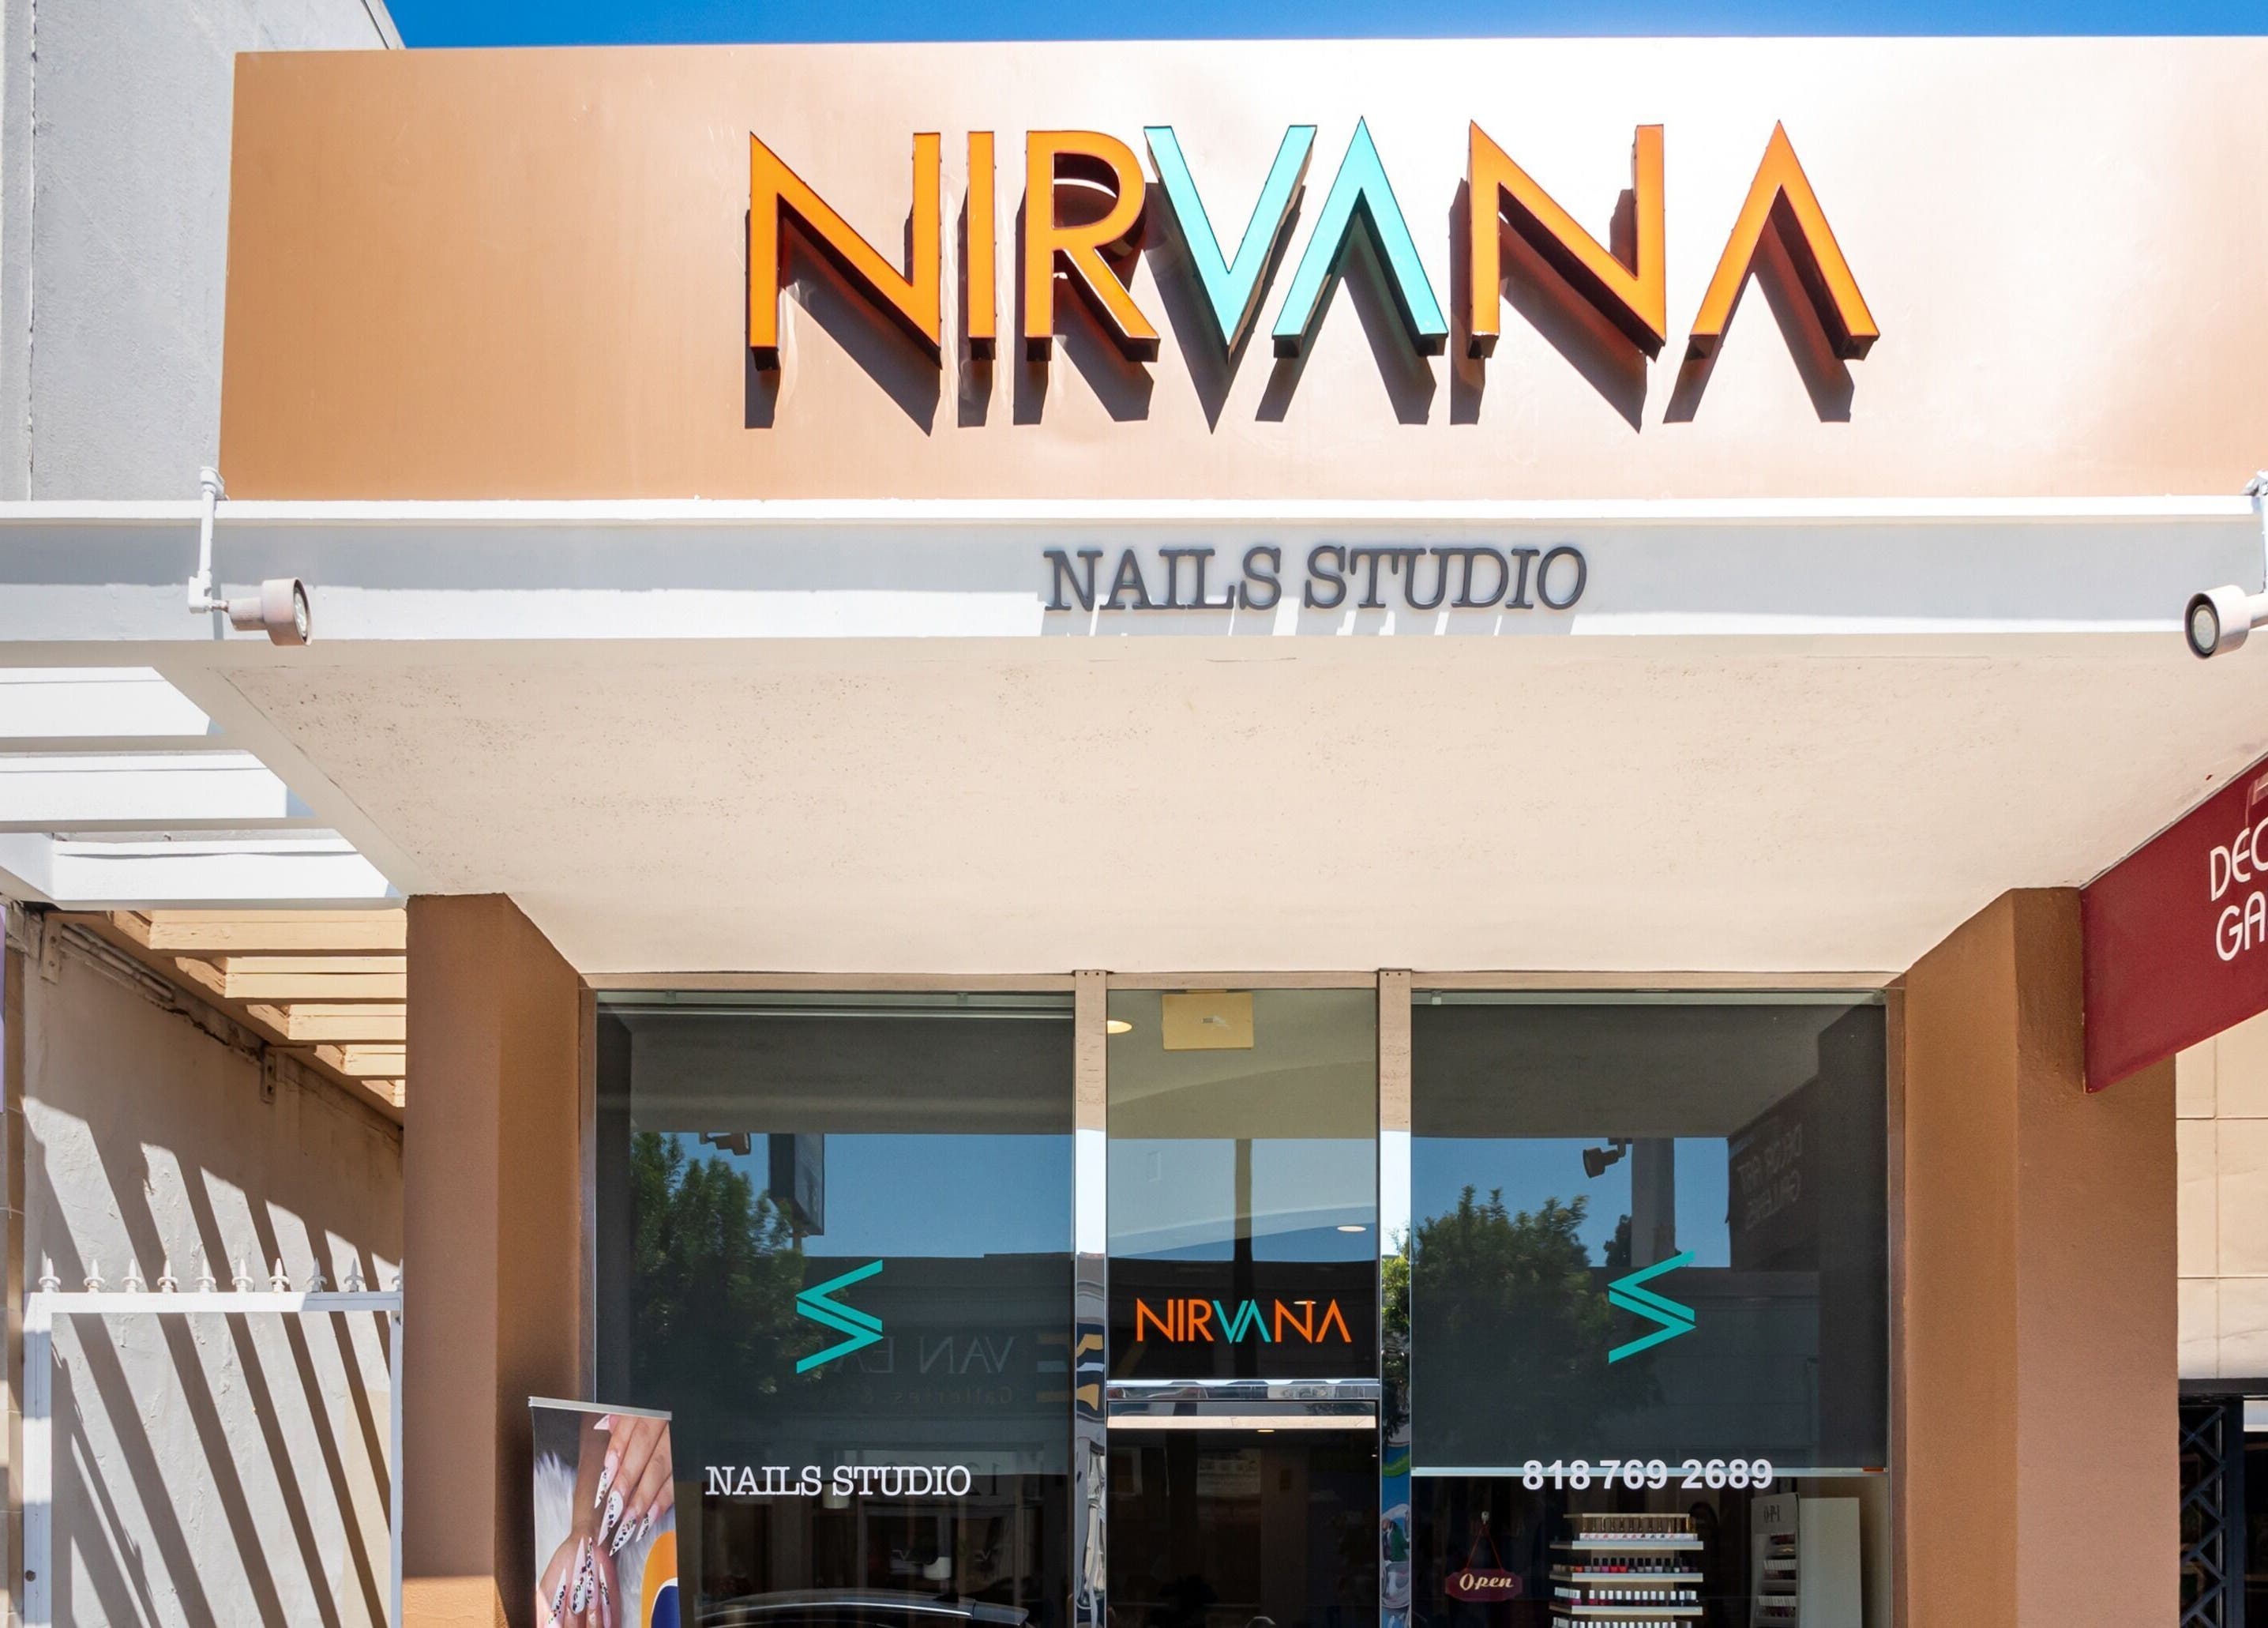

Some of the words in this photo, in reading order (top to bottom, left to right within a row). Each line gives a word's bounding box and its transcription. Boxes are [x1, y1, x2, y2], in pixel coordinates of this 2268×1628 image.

[749, 116, 1880, 355] NIRVANA
[1043, 547, 1282, 611] NAILS
[1304, 545, 1587, 611] STUDIO
[1136, 1299, 1351, 1343] NIRVANA
[705, 1465, 822, 1496] NAILS
[832, 1464, 971, 1496] STUDIO
[1523, 1460, 1590, 1490] 818
[1600, 1459, 1668, 1489] 769
[1681, 1459, 1773, 1489] 2689
[1459, 1572, 1514, 1591] Open
